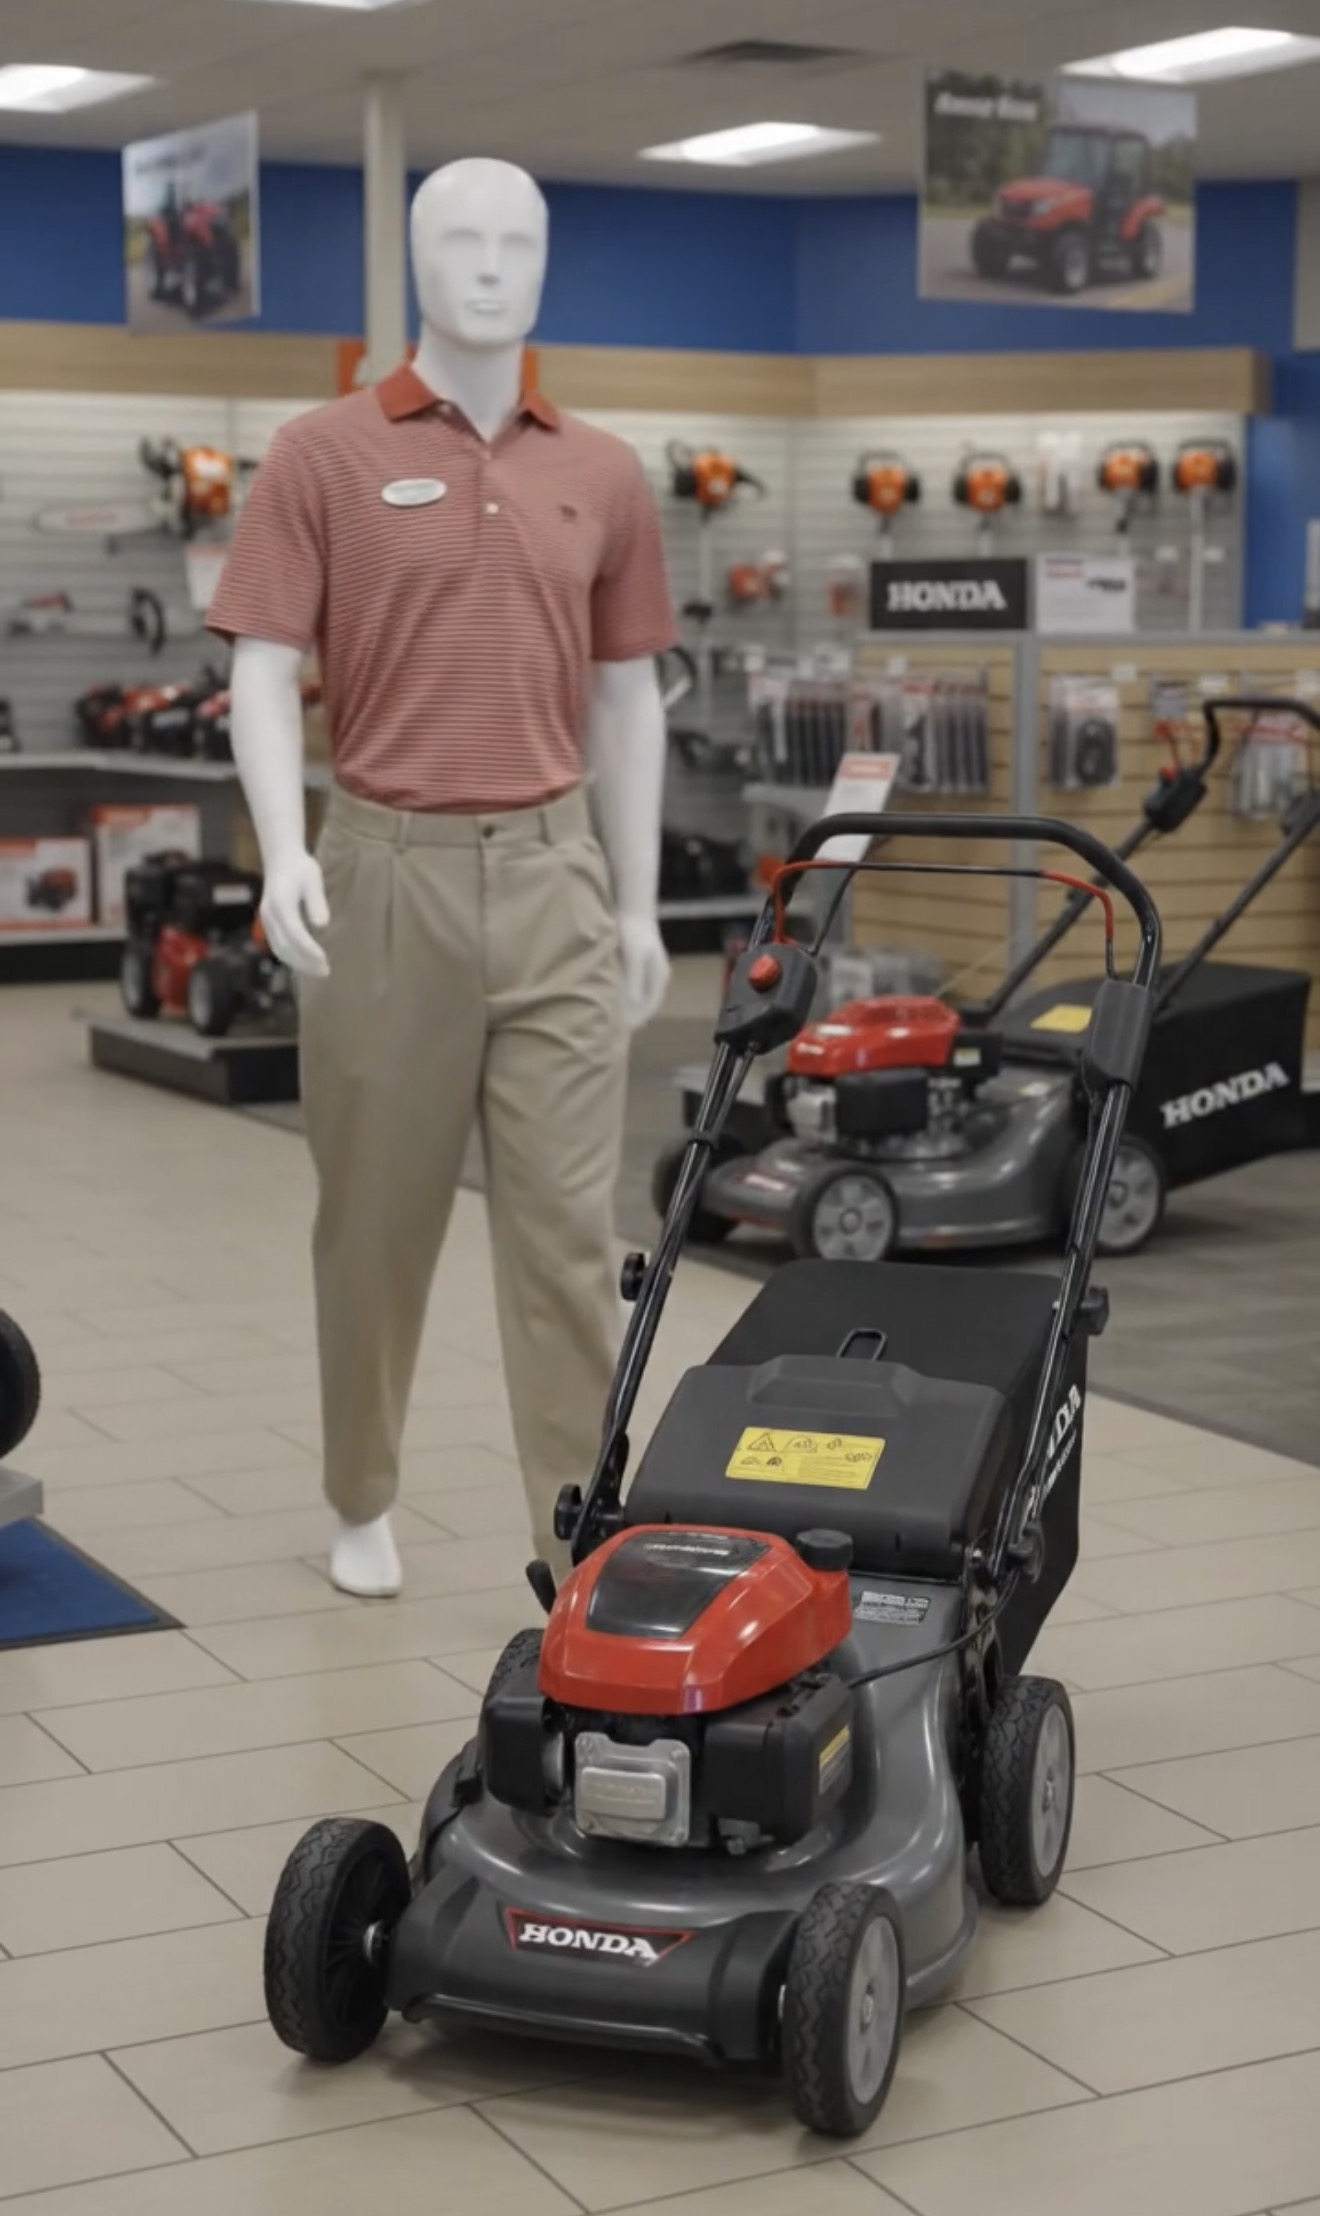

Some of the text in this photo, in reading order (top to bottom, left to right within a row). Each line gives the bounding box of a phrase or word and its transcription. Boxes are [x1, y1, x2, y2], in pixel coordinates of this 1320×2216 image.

[887, 579, 1007, 611] HONDA
[1160, 1062, 1290, 1129] HONDA
[519, 1923, 658, 1959] HONDA
